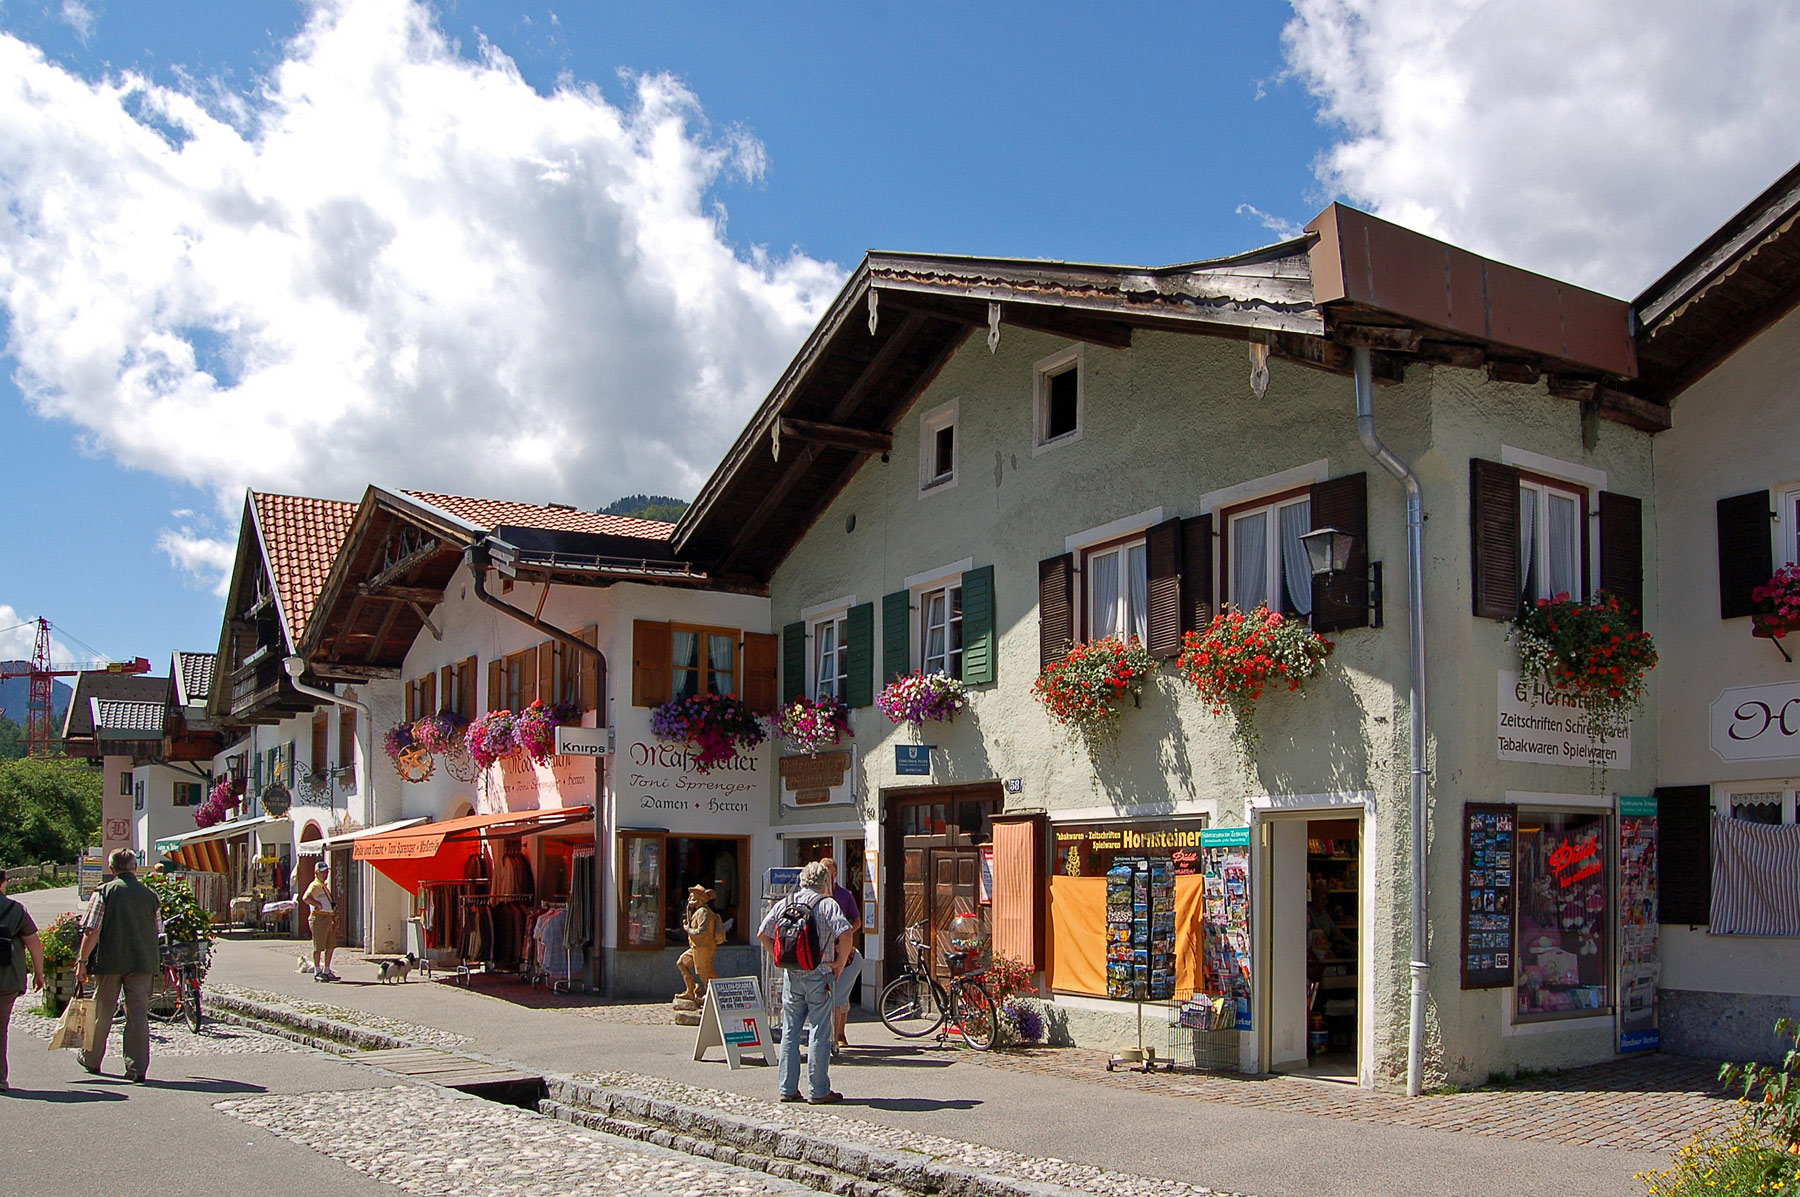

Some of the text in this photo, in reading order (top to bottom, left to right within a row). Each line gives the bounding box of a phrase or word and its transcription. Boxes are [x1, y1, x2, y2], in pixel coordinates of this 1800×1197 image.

[1515, 683, 1527, 702] G
[1500, 713, 1628, 738] Zeitschriften Schreibwaren
[562, 742, 606, 755] Knirps
[1498, 737, 1617, 760] Tabakwaren Spielwaren
[629, 774, 757, 796] Toni Sprenger
[1010, 780, 1019, 791] 58
[641, 795, 748, 813] Damen Herren
[1123, 828, 1201, 849] Hornsteiner
